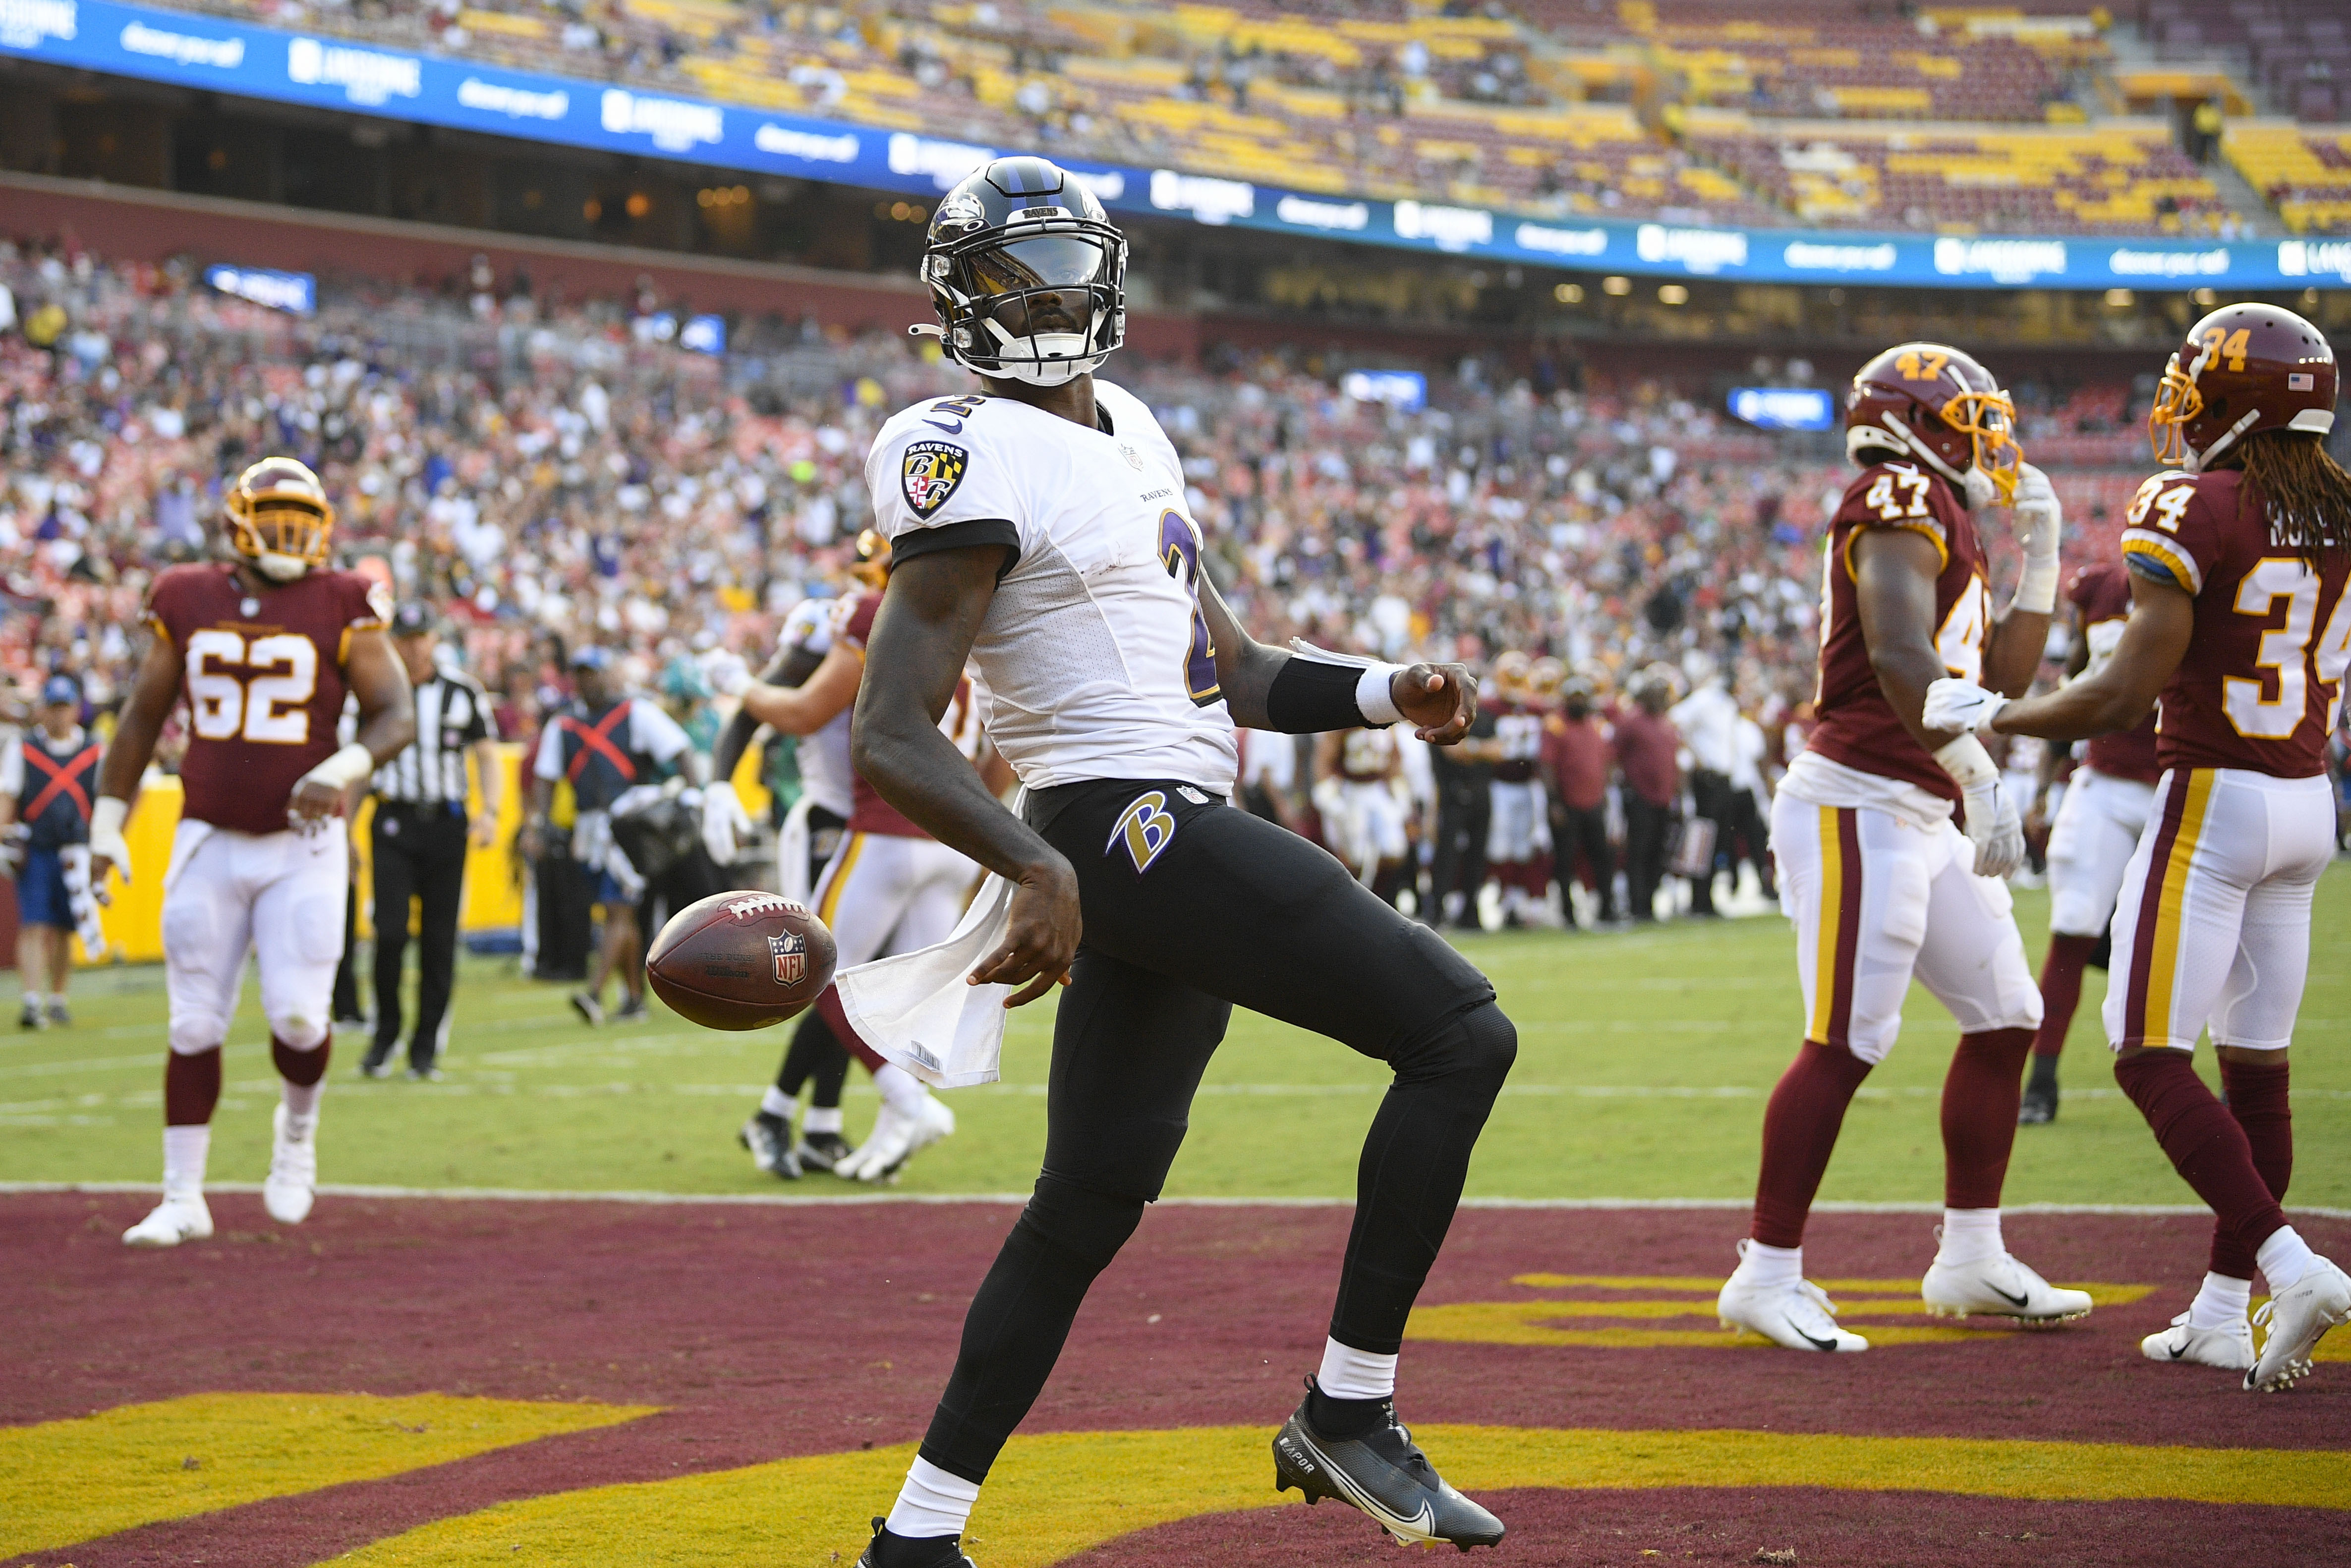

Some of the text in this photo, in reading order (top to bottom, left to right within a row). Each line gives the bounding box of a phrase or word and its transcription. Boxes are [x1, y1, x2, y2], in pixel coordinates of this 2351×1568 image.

[1022, 208, 1058, 219] RAVENS
[2203, 326, 2251, 373] 34
[1895, 351, 1949, 381] 47
[929, 394, 986, 418] 2
[907, 453, 935, 476] B
[908, 443, 963, 457] RAVENS
[925, 479, 953, 502] R
[1140, 489, 1173, 502] RAVENS
[1866, 474, 1931, 520] 47
[2126, 472, 2196, 534] 34
[1157, 507, 1223, 708] 2
[1934, 571, 1993, 685] 4
[185, 627, 319, 745] 62
[1104, 789, 1176, 876] B
[777, 954, 804, 981] NFL
